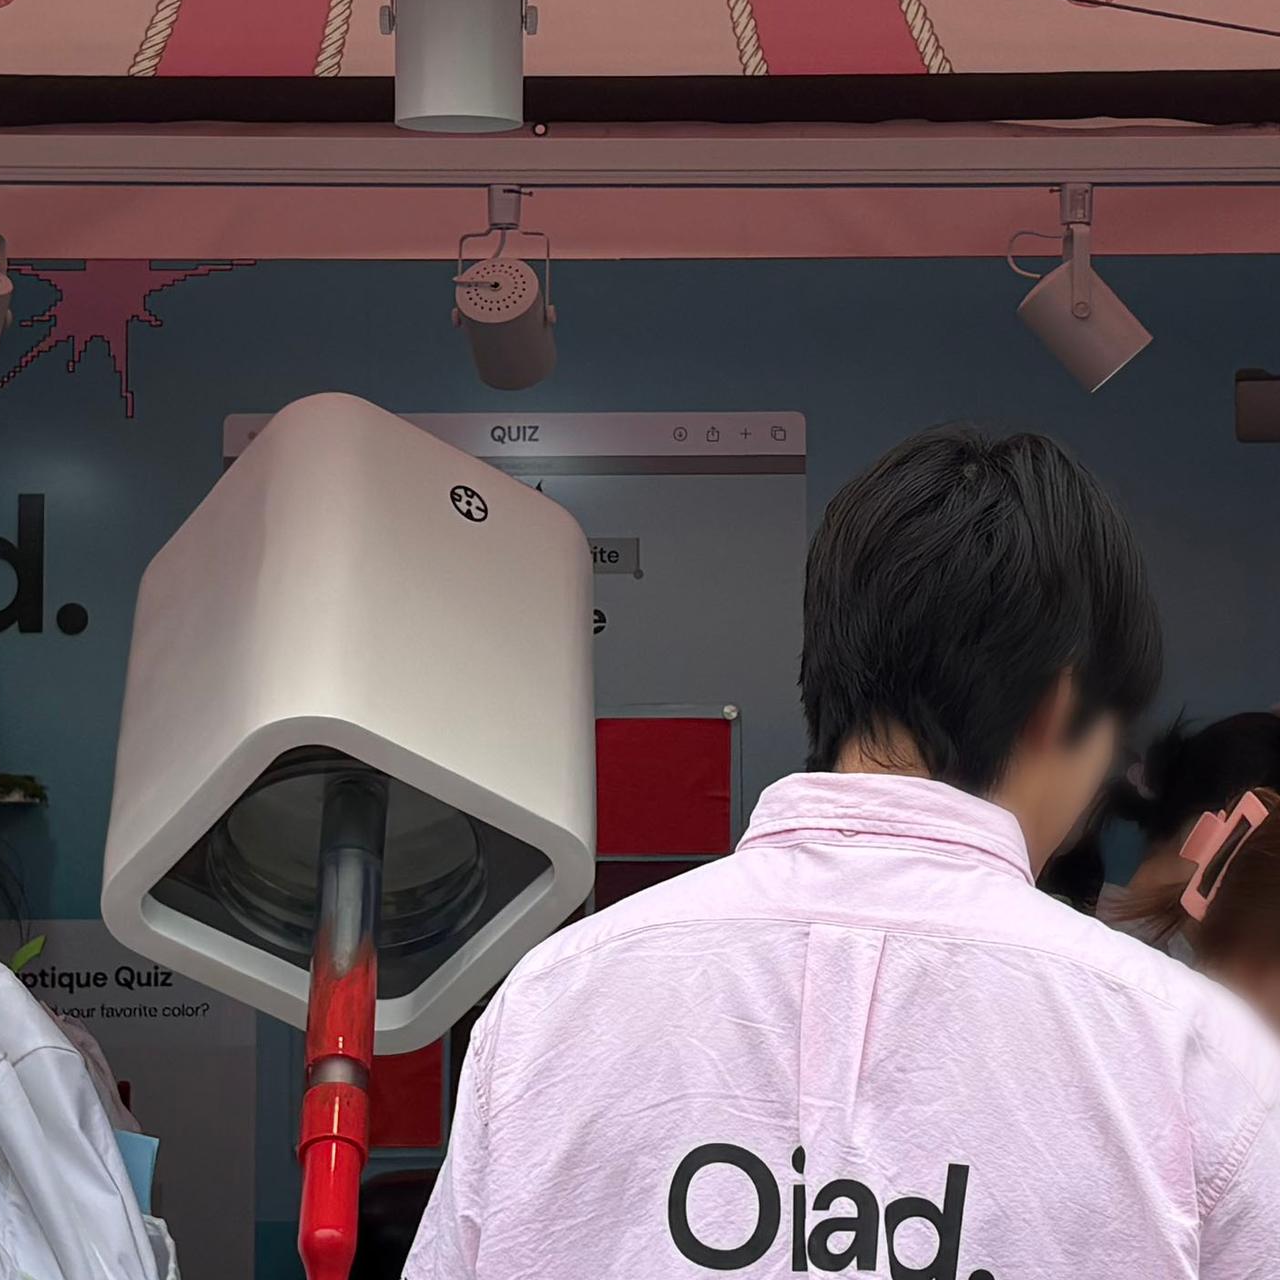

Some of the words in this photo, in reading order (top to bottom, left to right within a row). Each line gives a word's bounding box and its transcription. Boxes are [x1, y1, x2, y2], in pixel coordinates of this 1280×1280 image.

[490, 424, 540, 445] QUIZ
[17, 966, 108, 994] ptique
[115, 966, 173, 990] Quiz
[100, 1003, 157, 1019] favorite
[162, 1003, 210, 1019] color?
